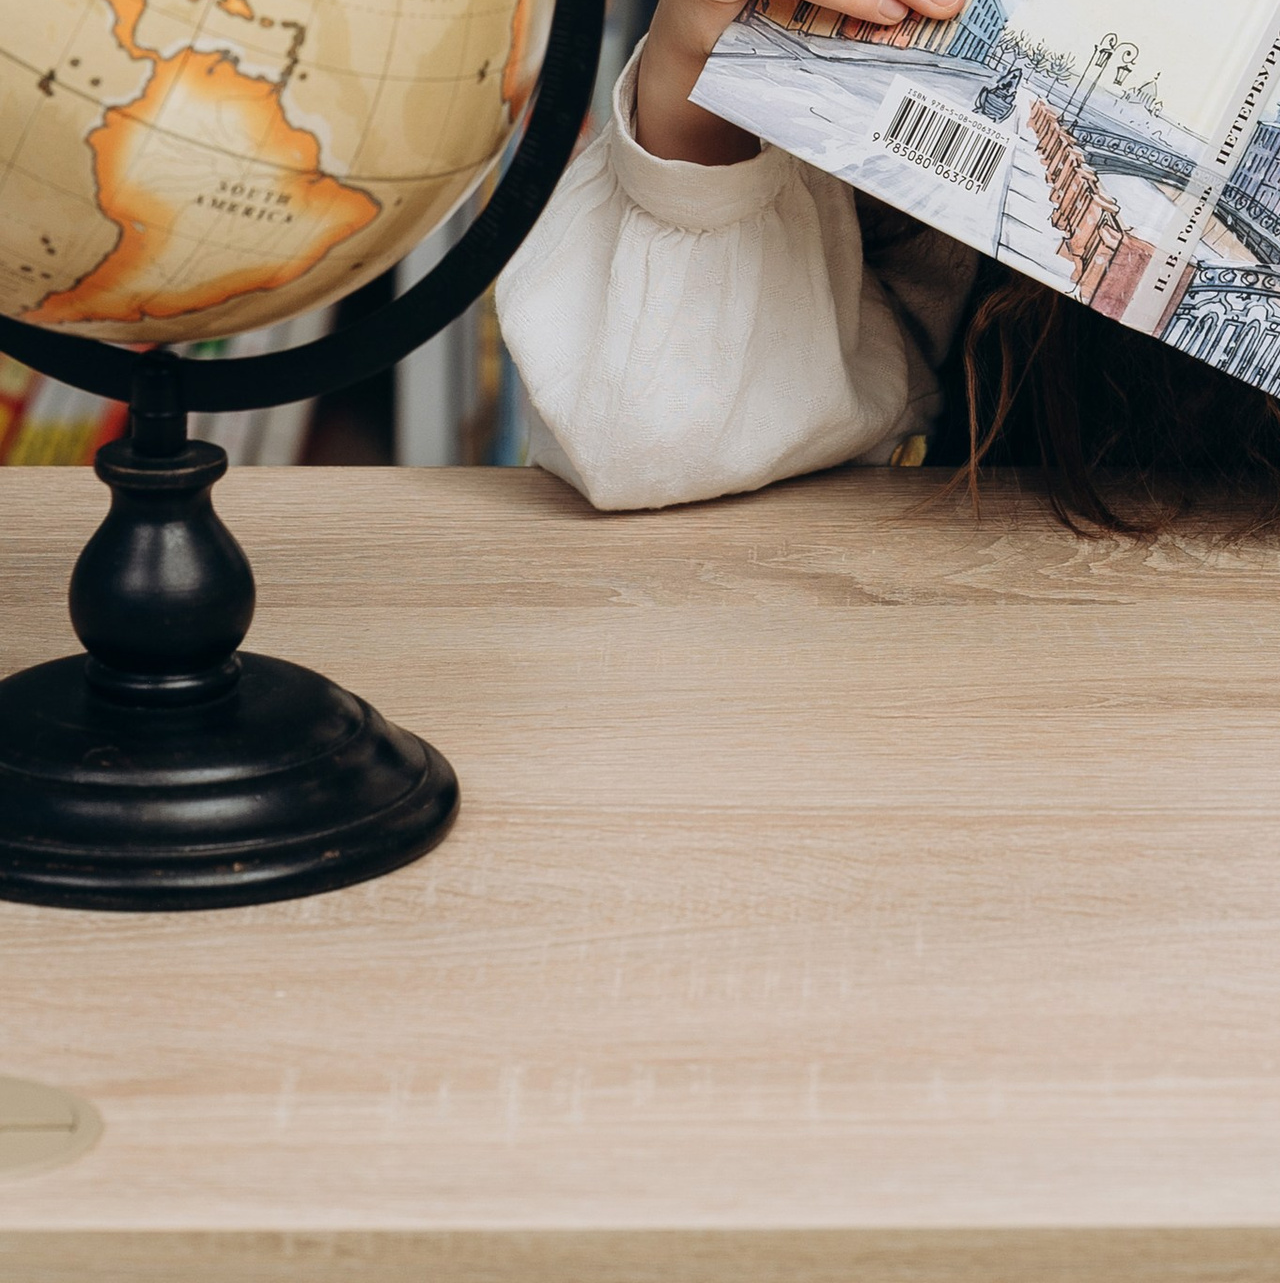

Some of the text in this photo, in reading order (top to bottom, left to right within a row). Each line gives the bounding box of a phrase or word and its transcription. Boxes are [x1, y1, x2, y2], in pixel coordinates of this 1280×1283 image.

[907, 88, 1010, 144] ISBN 978-5-08-006370-1
[1154, 185, 1213, 293] Н. В. Гоголь
